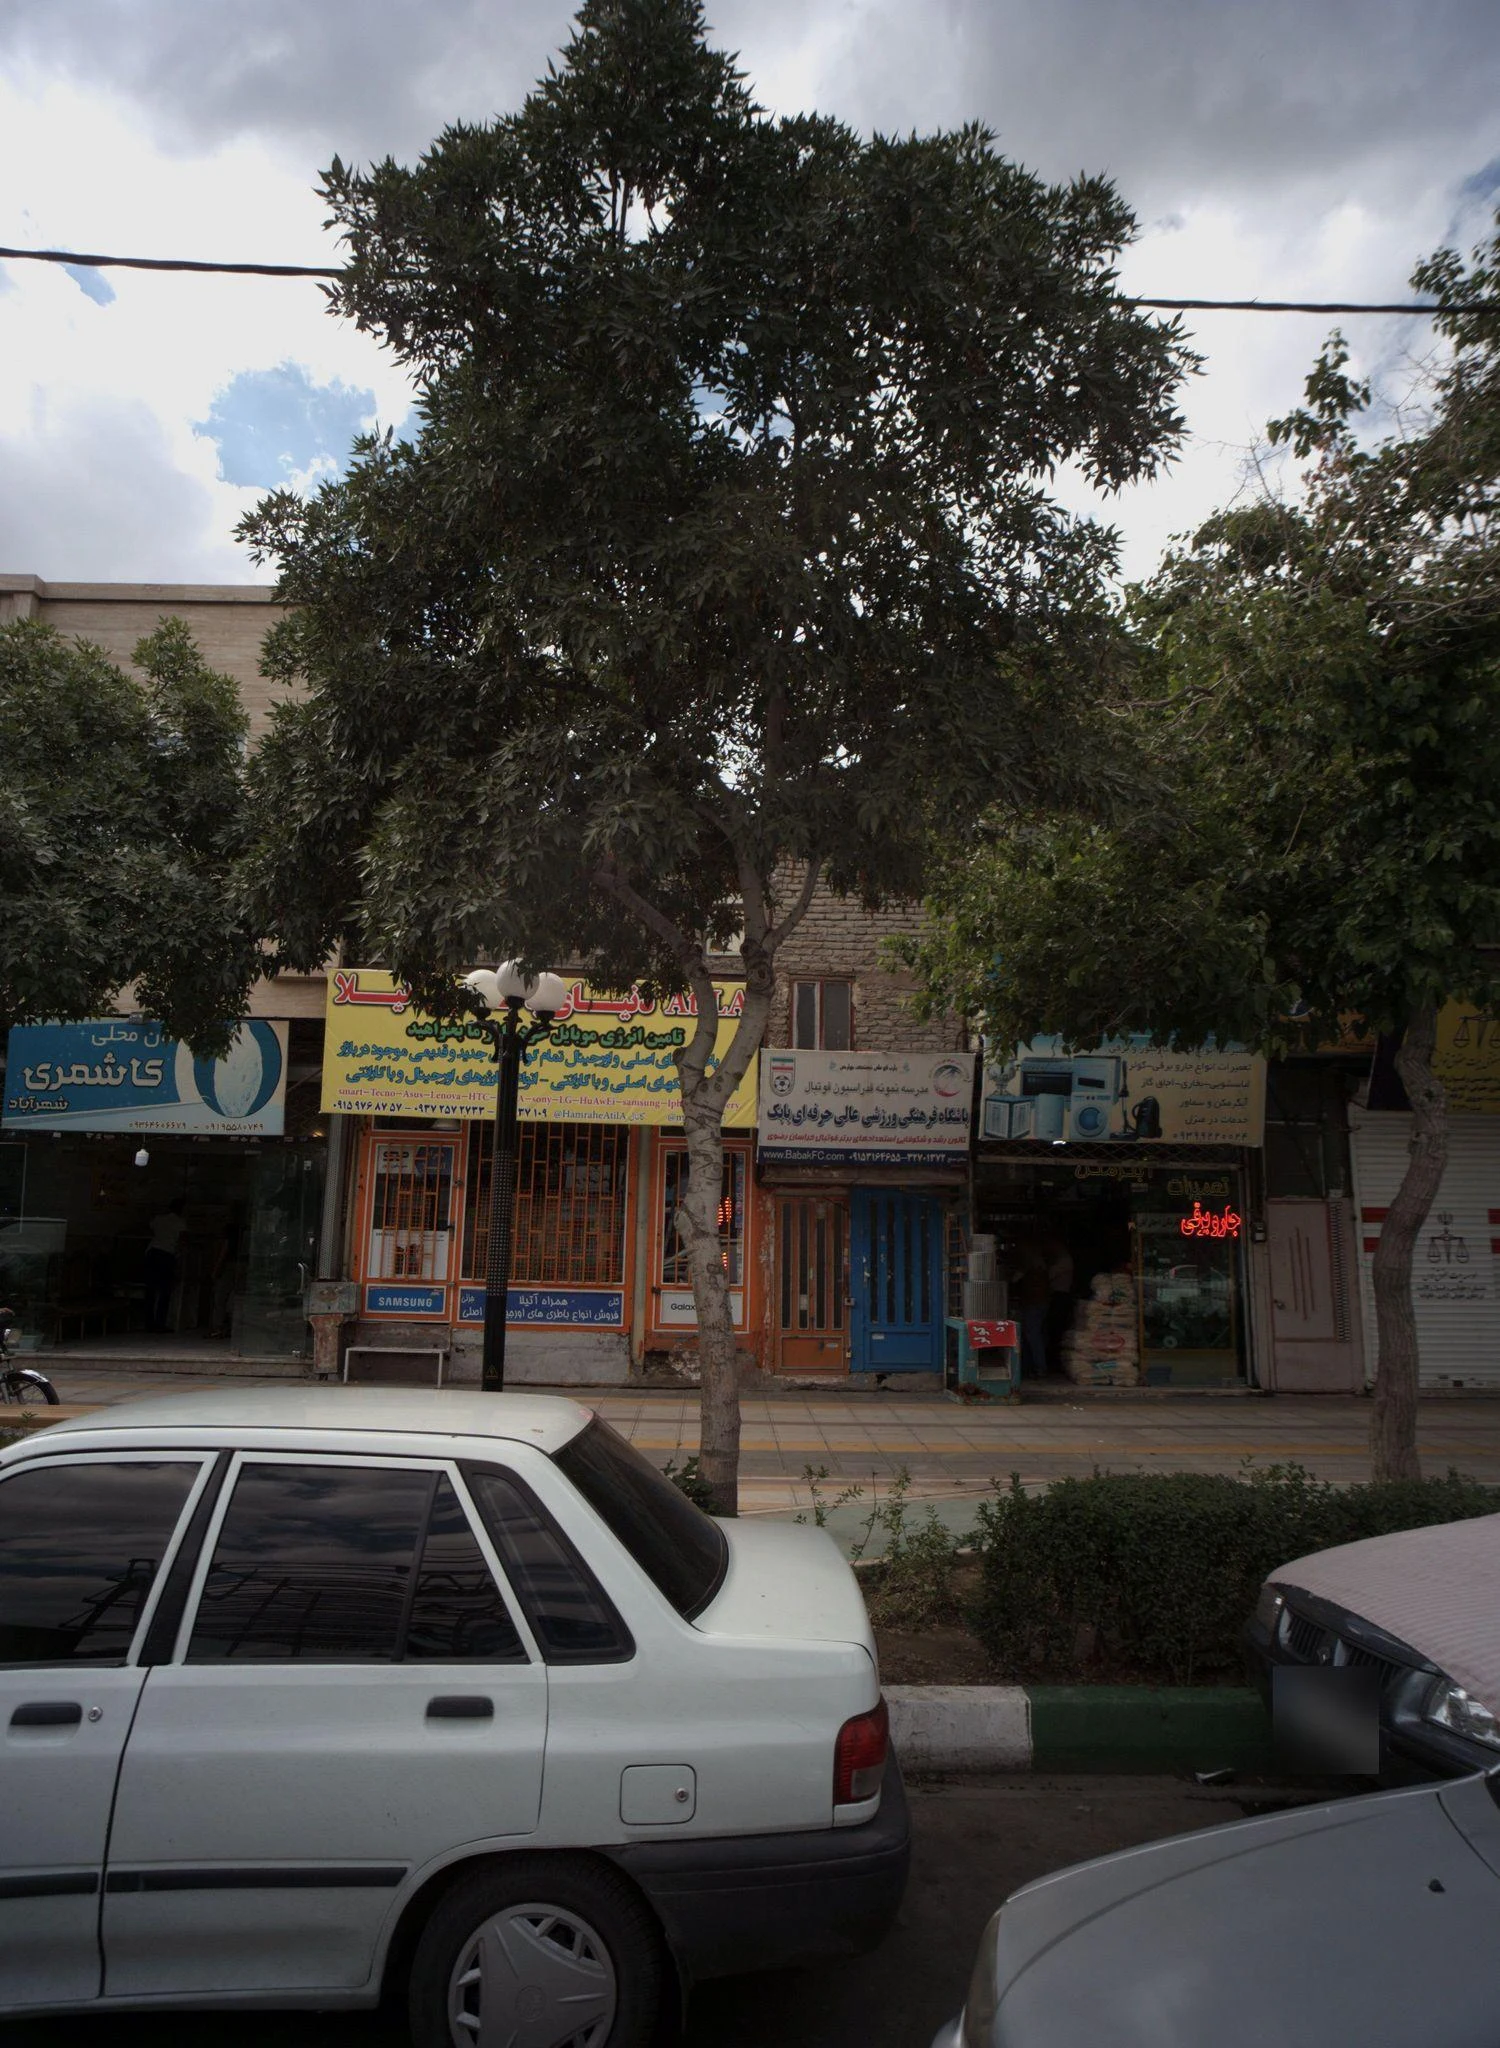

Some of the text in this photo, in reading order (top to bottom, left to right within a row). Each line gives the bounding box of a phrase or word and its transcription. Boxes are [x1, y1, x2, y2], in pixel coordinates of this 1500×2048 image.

[91, 1026, 138, 1047] محلی
[550, 1024, 598, 1046] موبایل
[23, 1051, 164, 1091] کاشمری
[763, 1149, 845, 1161] www.BabakFC.com
[378, 1295, 433, 1308] SAMSUNG
[518, 1293, 568, 1307] همراه آتیلا
[572, 1310, 592, 1321] انواع
[594, 1311, 619, 1322] فروش
